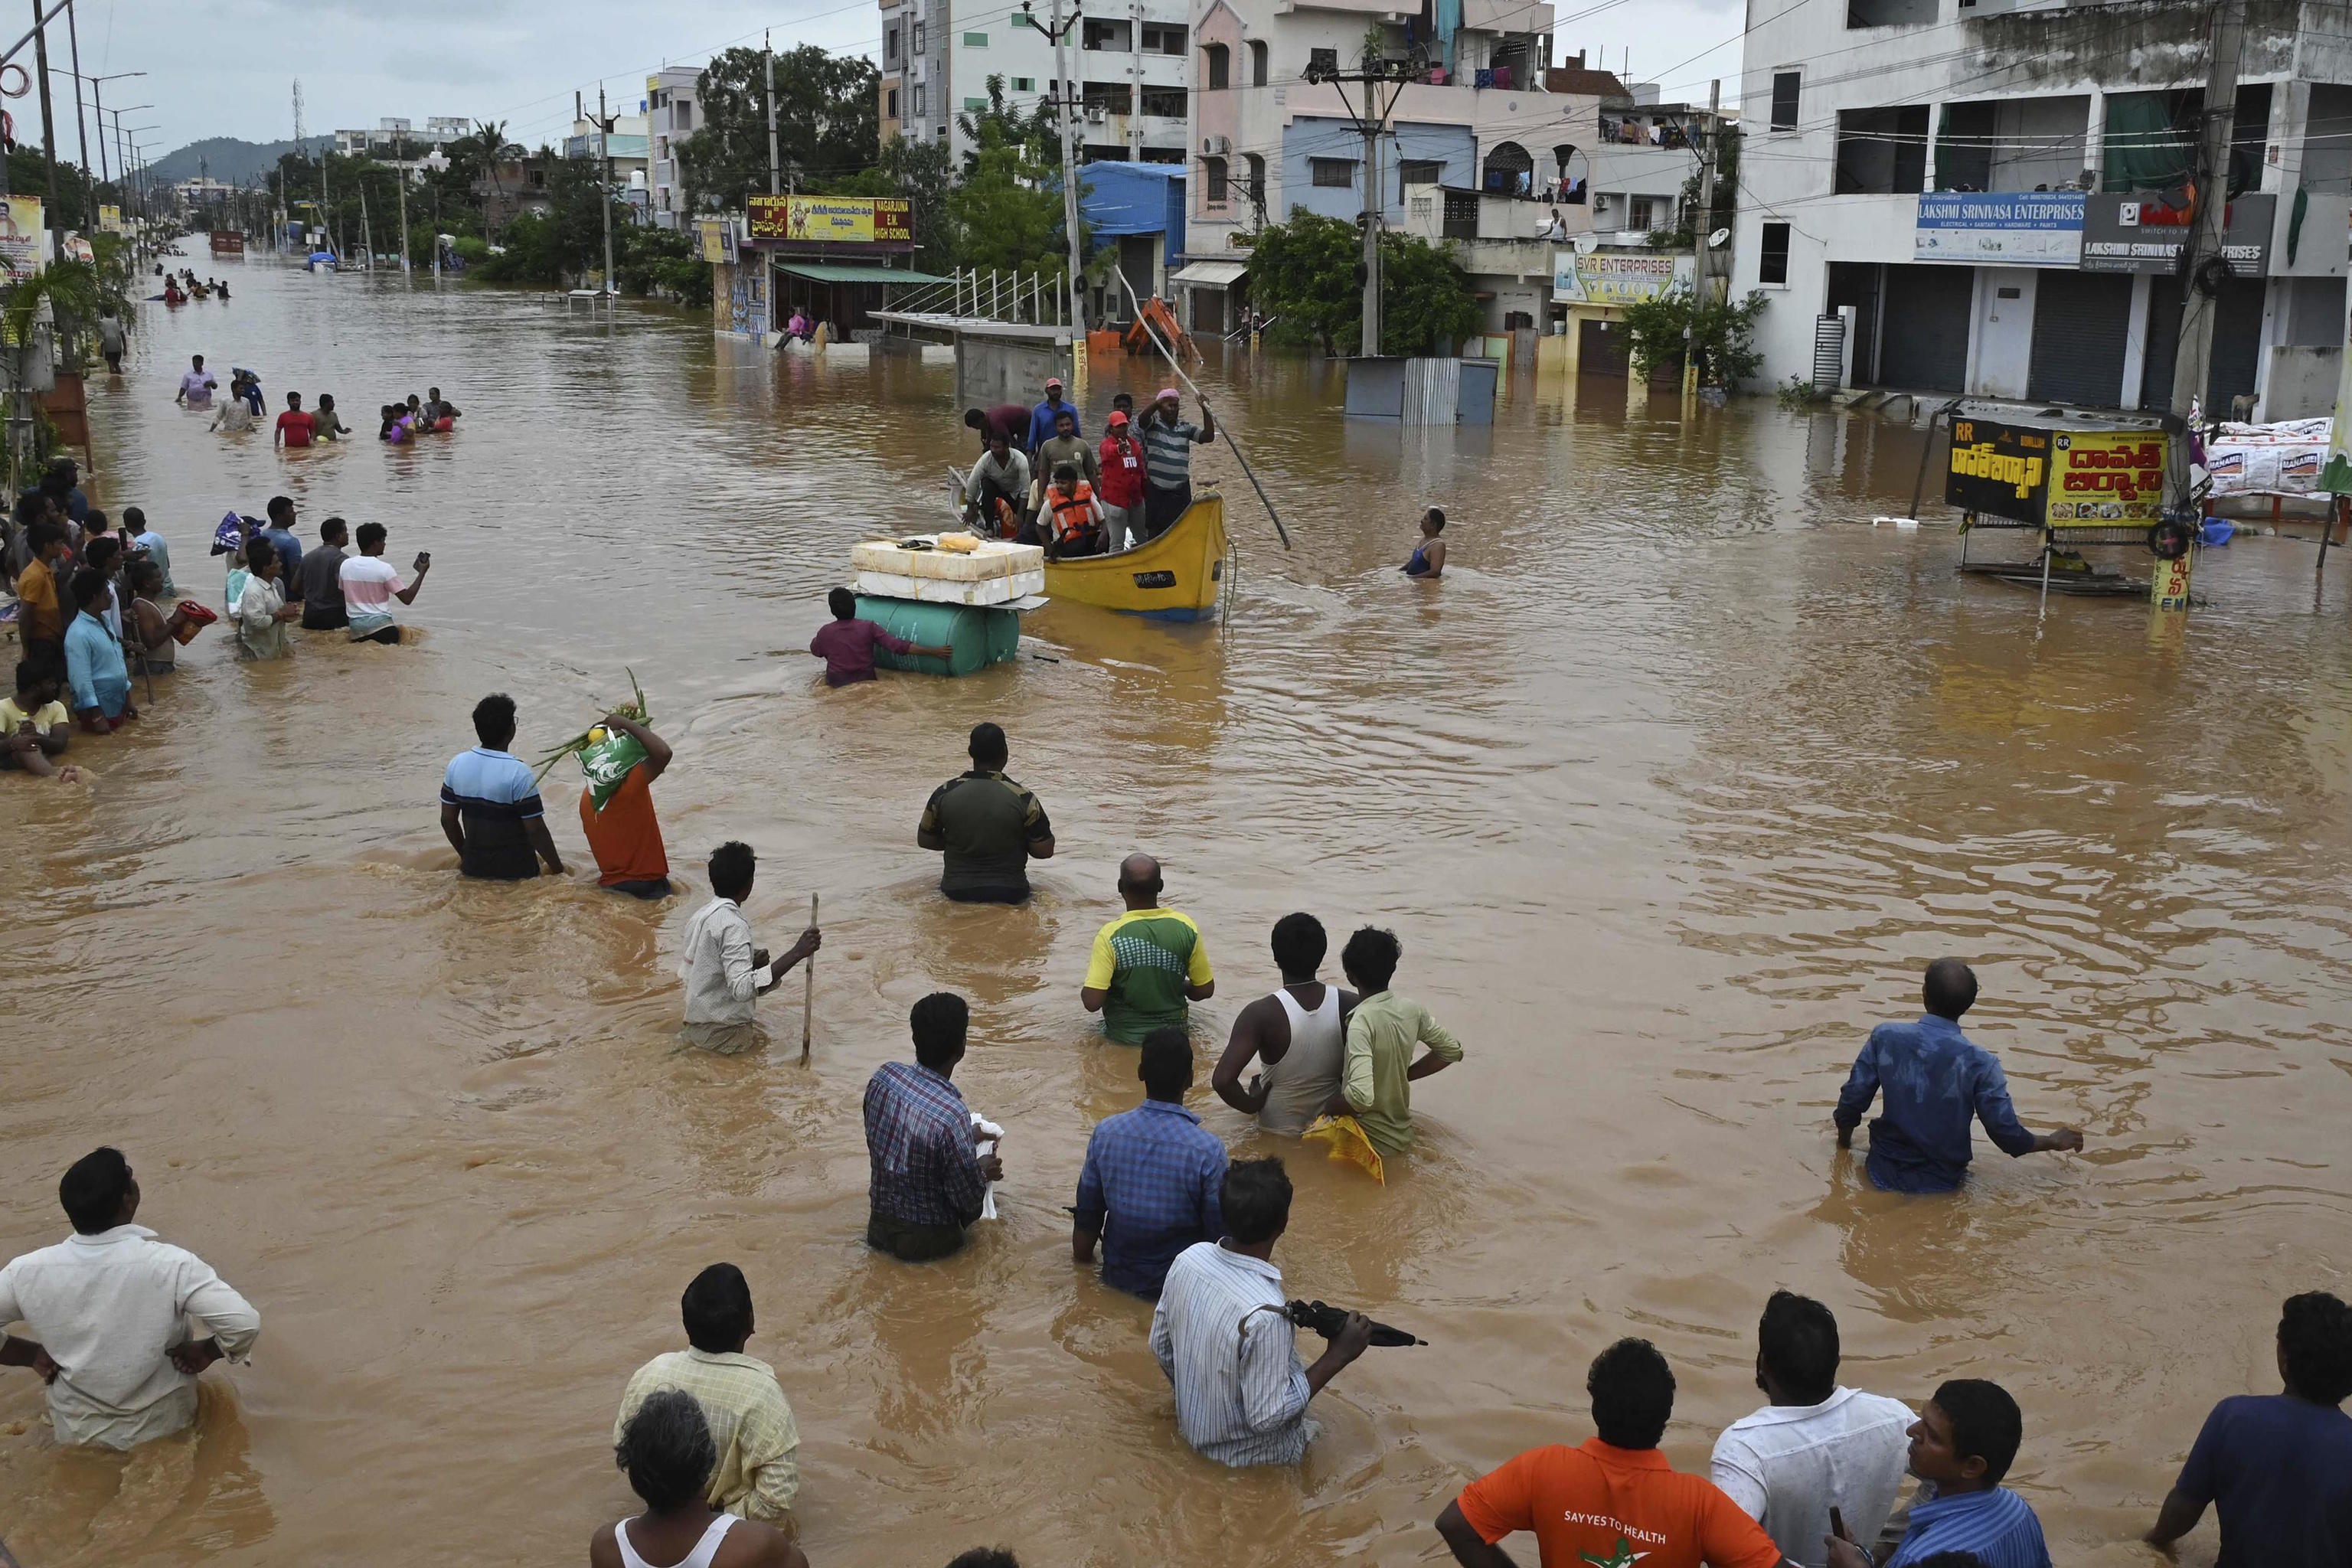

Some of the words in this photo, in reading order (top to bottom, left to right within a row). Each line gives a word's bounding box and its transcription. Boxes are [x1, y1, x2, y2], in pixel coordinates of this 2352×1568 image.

[876, 201, 909, 213] NAGARJUNA
[1919, 204, 1959, 219] LAKSHMI
[1962, 204, 2011, 220] SRINIVASA
[2014, 204, 2085, 220] ENTERPRISES
[874, 228, 888, 239] HIGH
[889, 228, 910, 240] SCHOOL
[2085, 242, 2130, 256] LAKSHMI
[2131, 243, 2184, 258] SRINIVAS
[1577, 256, 1597, 271] SVR
[1600, 258, 1672, 274] ENTERPRISES
[1955, 422, 1974, 442] RR
[2056, 438, 2069, 447] RR
[1123, 456, 1137, 468] IFTU
[2068, 443, 2163, 469] దావత్
[2063, 471, 2164, 501] బిర్యాని
[1564, 1510, 1586, 1522] SAY
[1586, 1514, 1606, 1527] YES
[1609, 1517, 1622, 1530] TO
[1624, 1524, 1666, 1544] HEALTH
